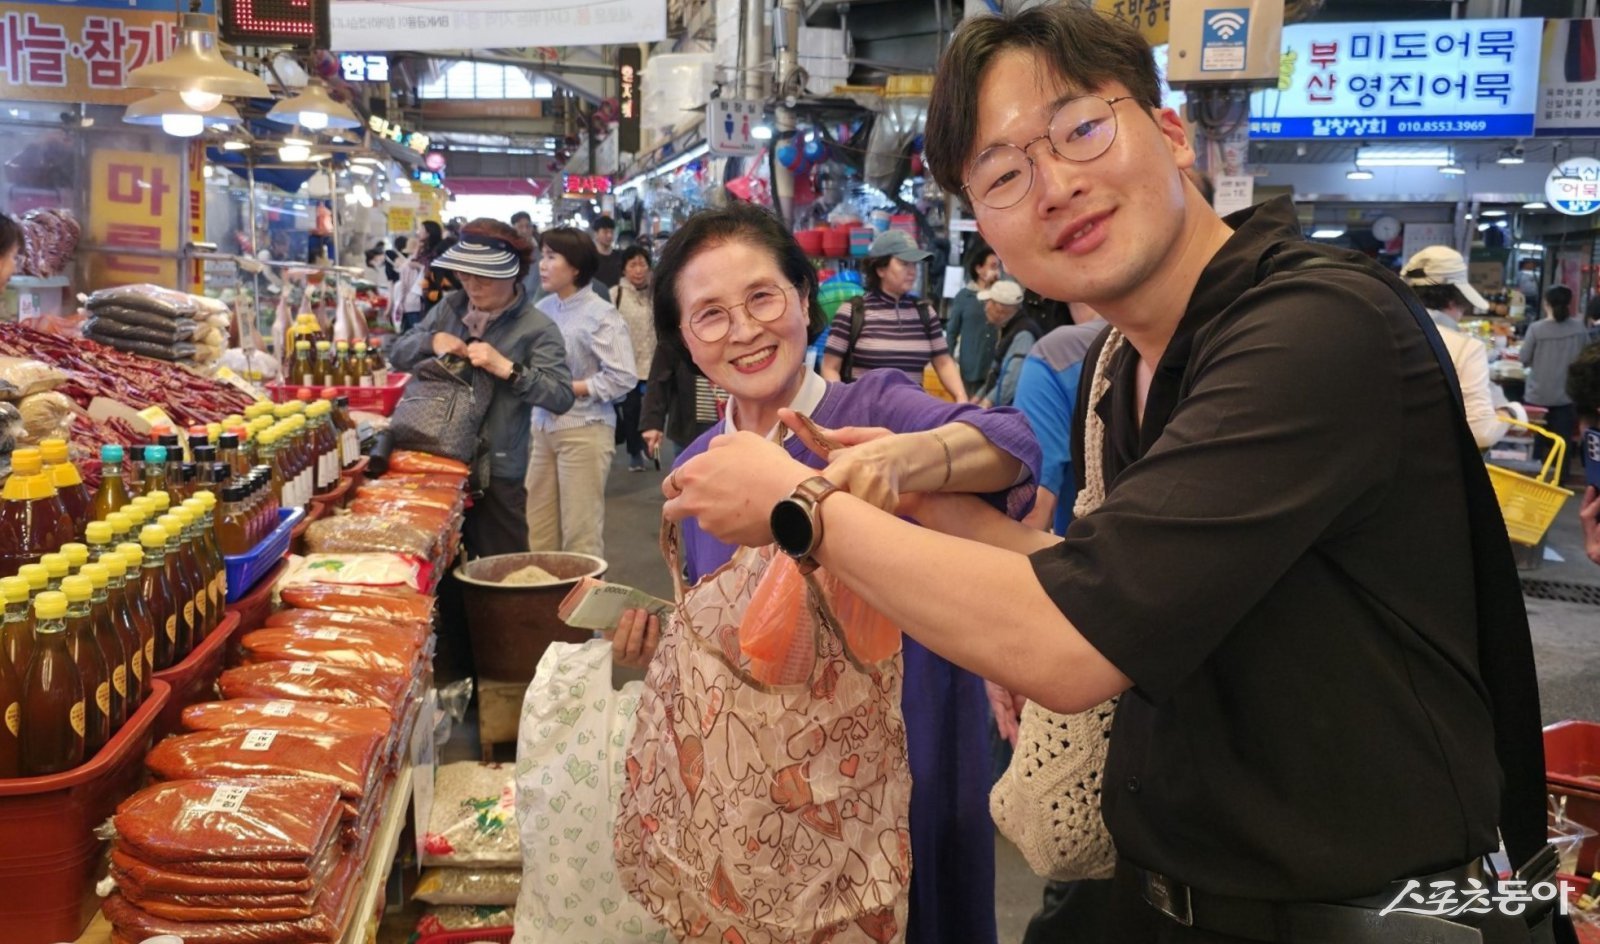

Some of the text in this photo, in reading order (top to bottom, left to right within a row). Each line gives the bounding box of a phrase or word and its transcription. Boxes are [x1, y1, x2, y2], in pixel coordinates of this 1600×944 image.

[0, 14, 178, 86] 마늘·참기
[1351, 31, 1515, 62] 미도어묵
[1308, 42, 1338, 102] 부산
[1349, 73, 1512, 107] 영진어묵
[1398, 121, 1487, 133] 010.8553.3969
